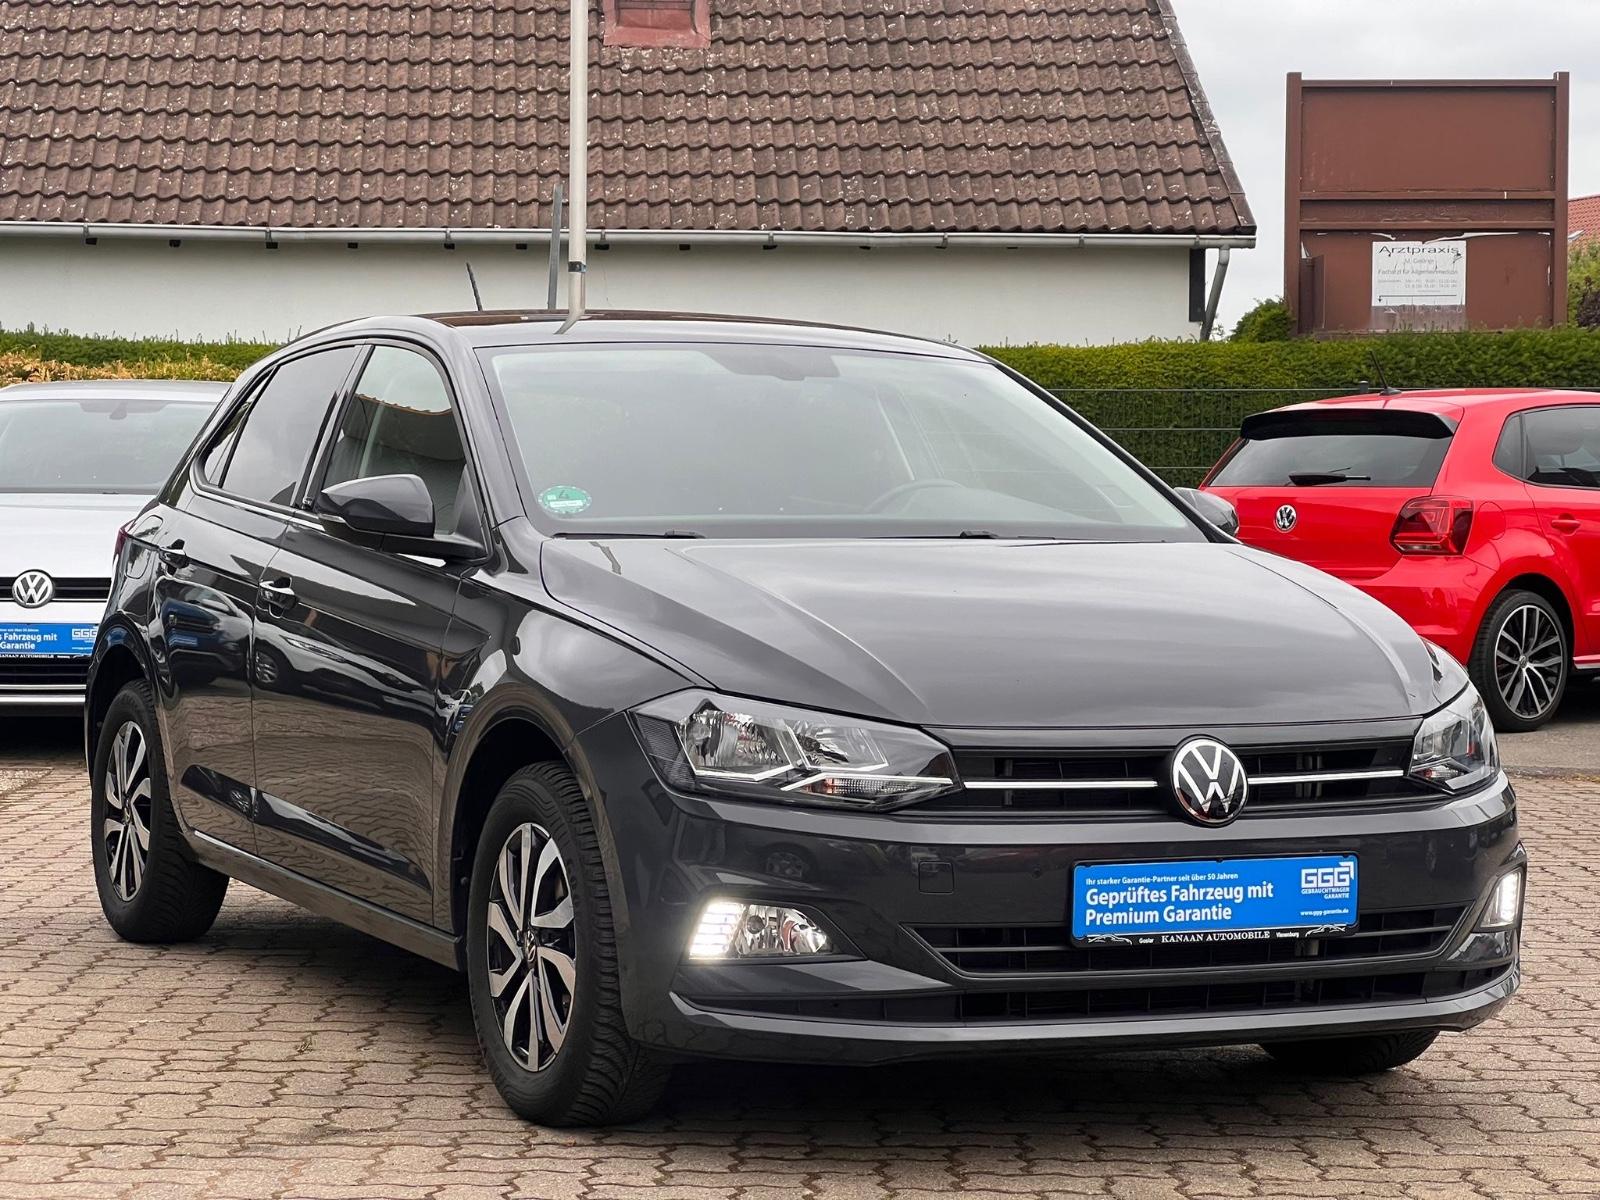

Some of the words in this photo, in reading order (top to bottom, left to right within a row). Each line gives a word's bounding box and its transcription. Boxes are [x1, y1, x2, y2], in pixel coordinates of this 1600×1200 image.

[1379, 246, 1460, 256] Arztpraxis
[4, 632, 42, 643] Fahrzeug
[43, 632, 58, 641] mit
[0, 641, 36, 650] Garantie
[1097, 877, 1121, 885] starker
[1122, 875, 1177, 885] Garantie-Partner
[1178, 874, 1190, 882] seit
[1191, 873, 1206, 881] über
[1207, 873, 1216, 881] 50
[1216, 872, 1238, 881] Jahren
[1301, 866, 1350, 888] GGG
[1086, 886, 1167, 909] Geprüftes
[1171, 883, 1244, 903] Fahrzeug
[1248, 880, 1274, 898] mit
[1323, 892, 1350, 900] GARANTIE
[1085, 907, 1160, 926] Premium
[1163, 903, 1232, 923] Garantie
[1161, 933, 1205, 944] KANAAN
[1206, 930, 1270, 941] AUTOMOBILE
